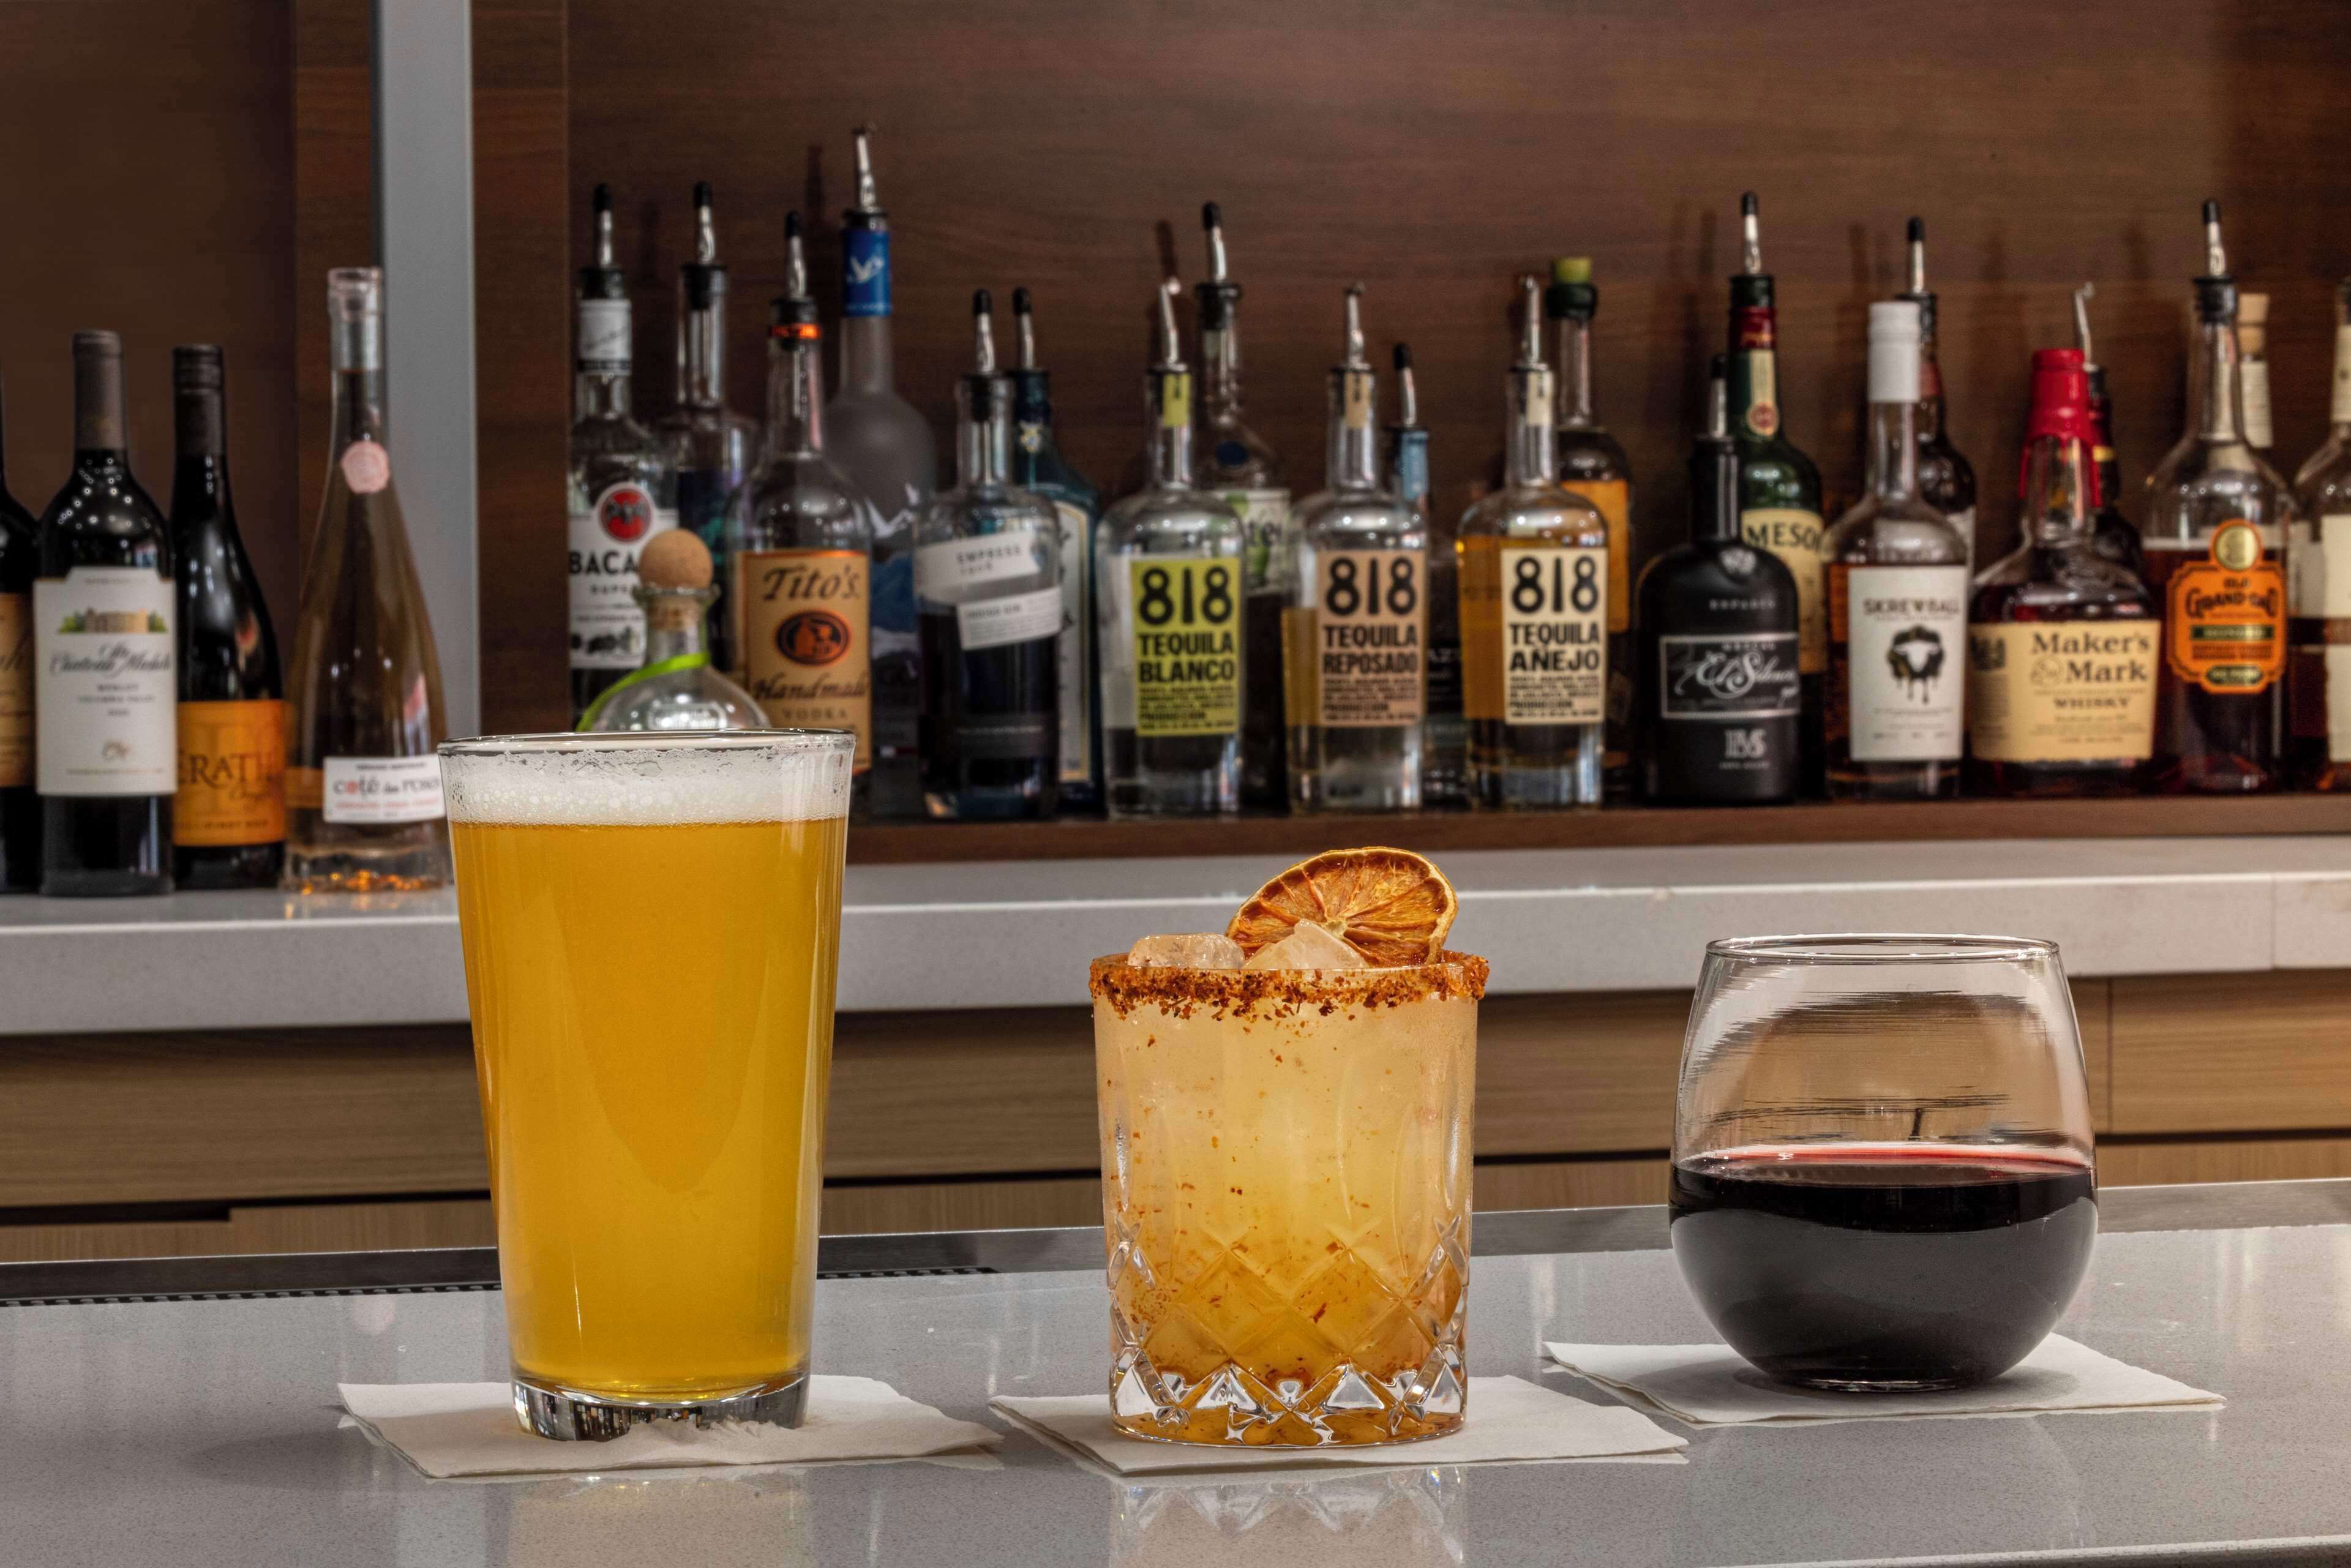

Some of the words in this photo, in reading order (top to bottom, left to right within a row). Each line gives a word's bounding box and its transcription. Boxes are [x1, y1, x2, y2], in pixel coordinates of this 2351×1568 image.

[568, 550, 639, 576] BACA
[763, 563, 860, 601] Tito's
[1326, 557, 1417, 616] 818
[1512, 555, 1599, 613] 818
[1139, 566, 1233, 626] 818
[1139, 631, 1233, 656] TEQUILA
[1323, 623, 1417, 648] TEQUILA
[1509, 621, 1600, 646] TEQUILA
[2031, 631, 2150, 655] Maker's
[1139, 659, 1234, 683] BLANCO
[1323, 651, 1418, 673] REPOSADO
[1510, 647, 1600, 672] AÑEJO
[2066, 658, 2148, 683] Mark
